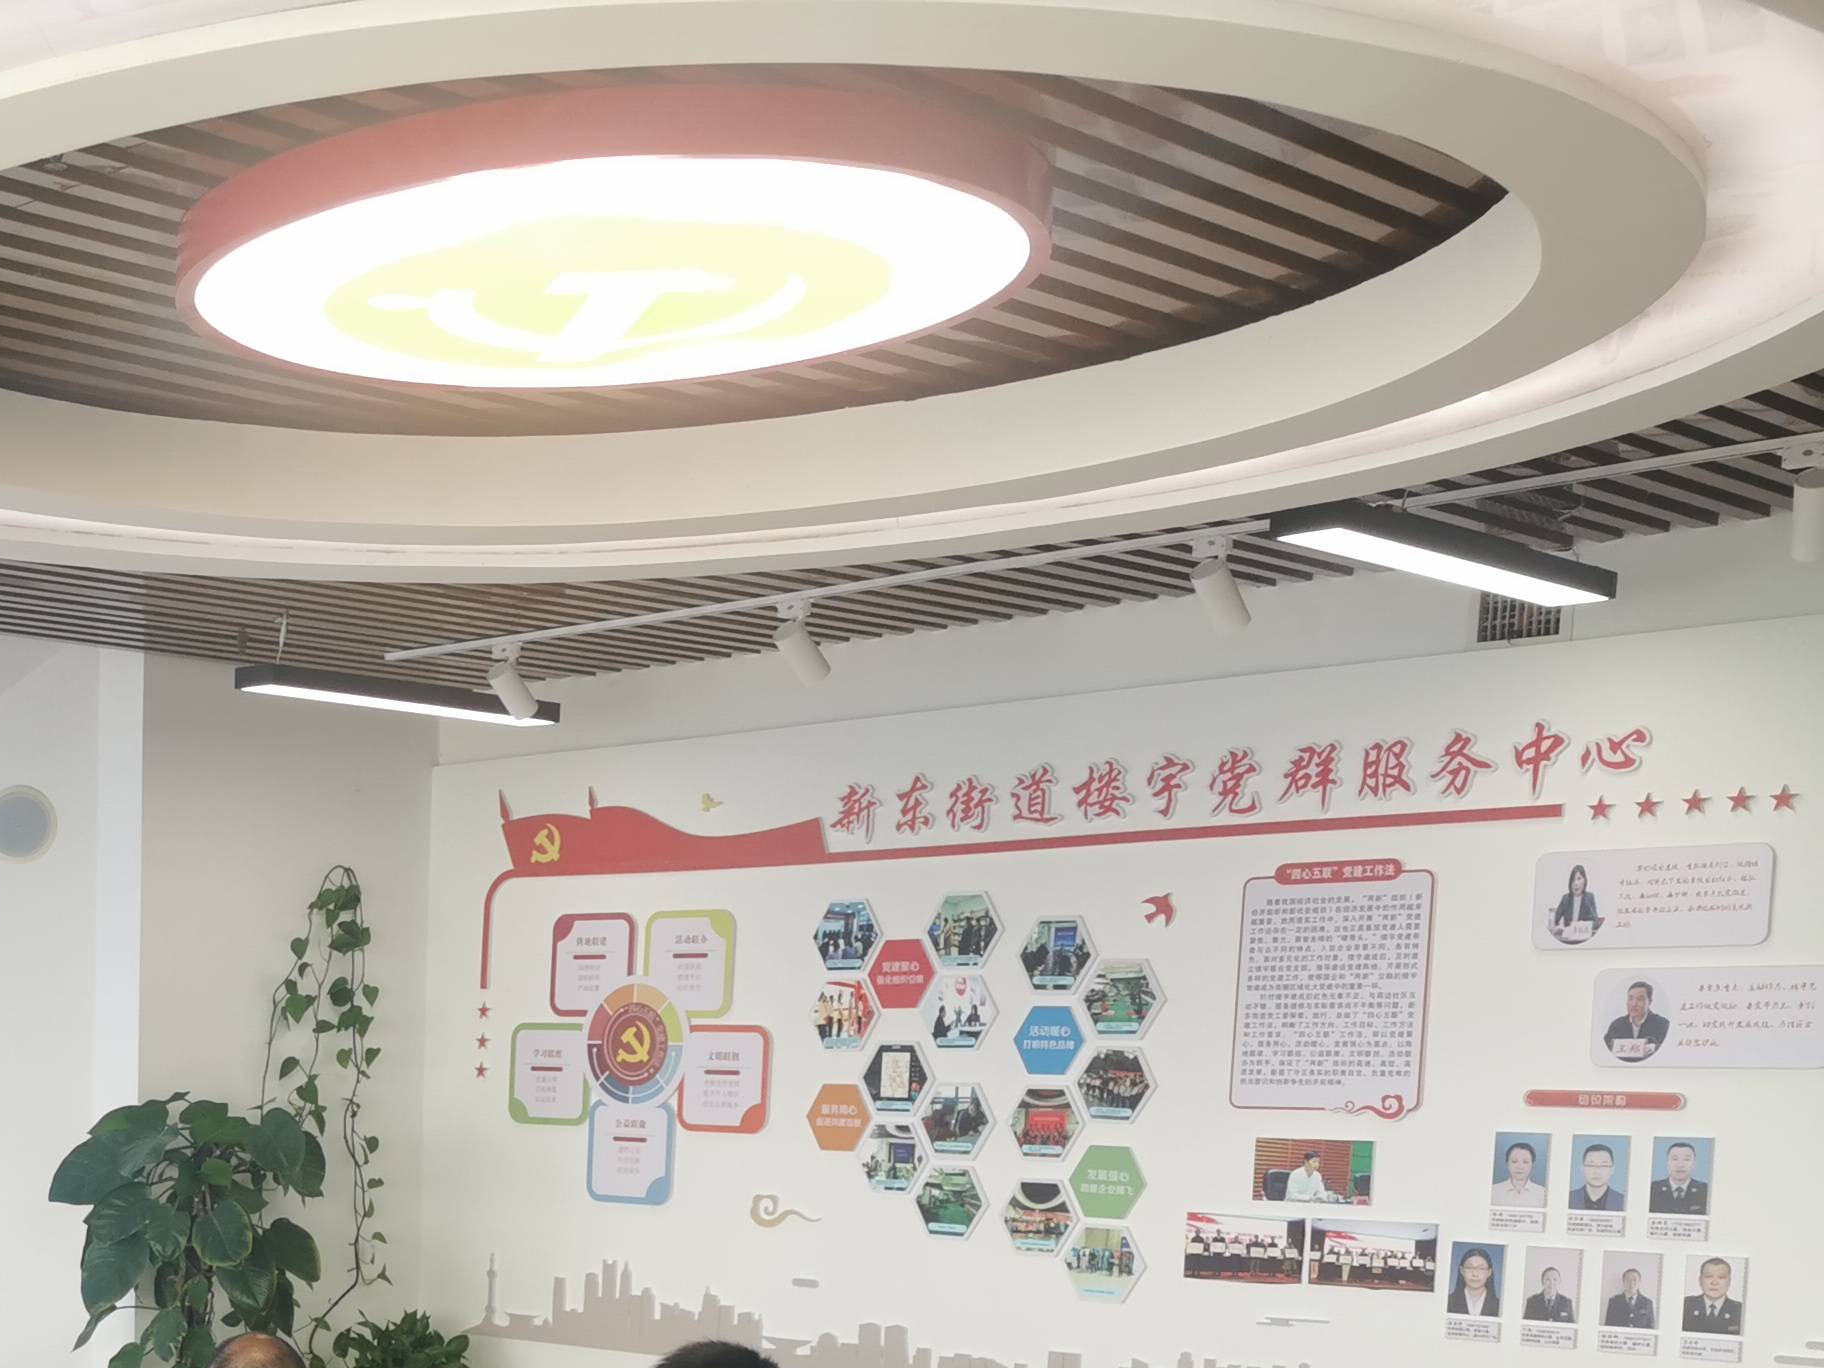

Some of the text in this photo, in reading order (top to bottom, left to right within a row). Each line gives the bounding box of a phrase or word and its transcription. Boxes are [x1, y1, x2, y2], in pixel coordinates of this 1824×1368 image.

[829, 720, 1650, 844] 新东街道楼宇党群服务中心
